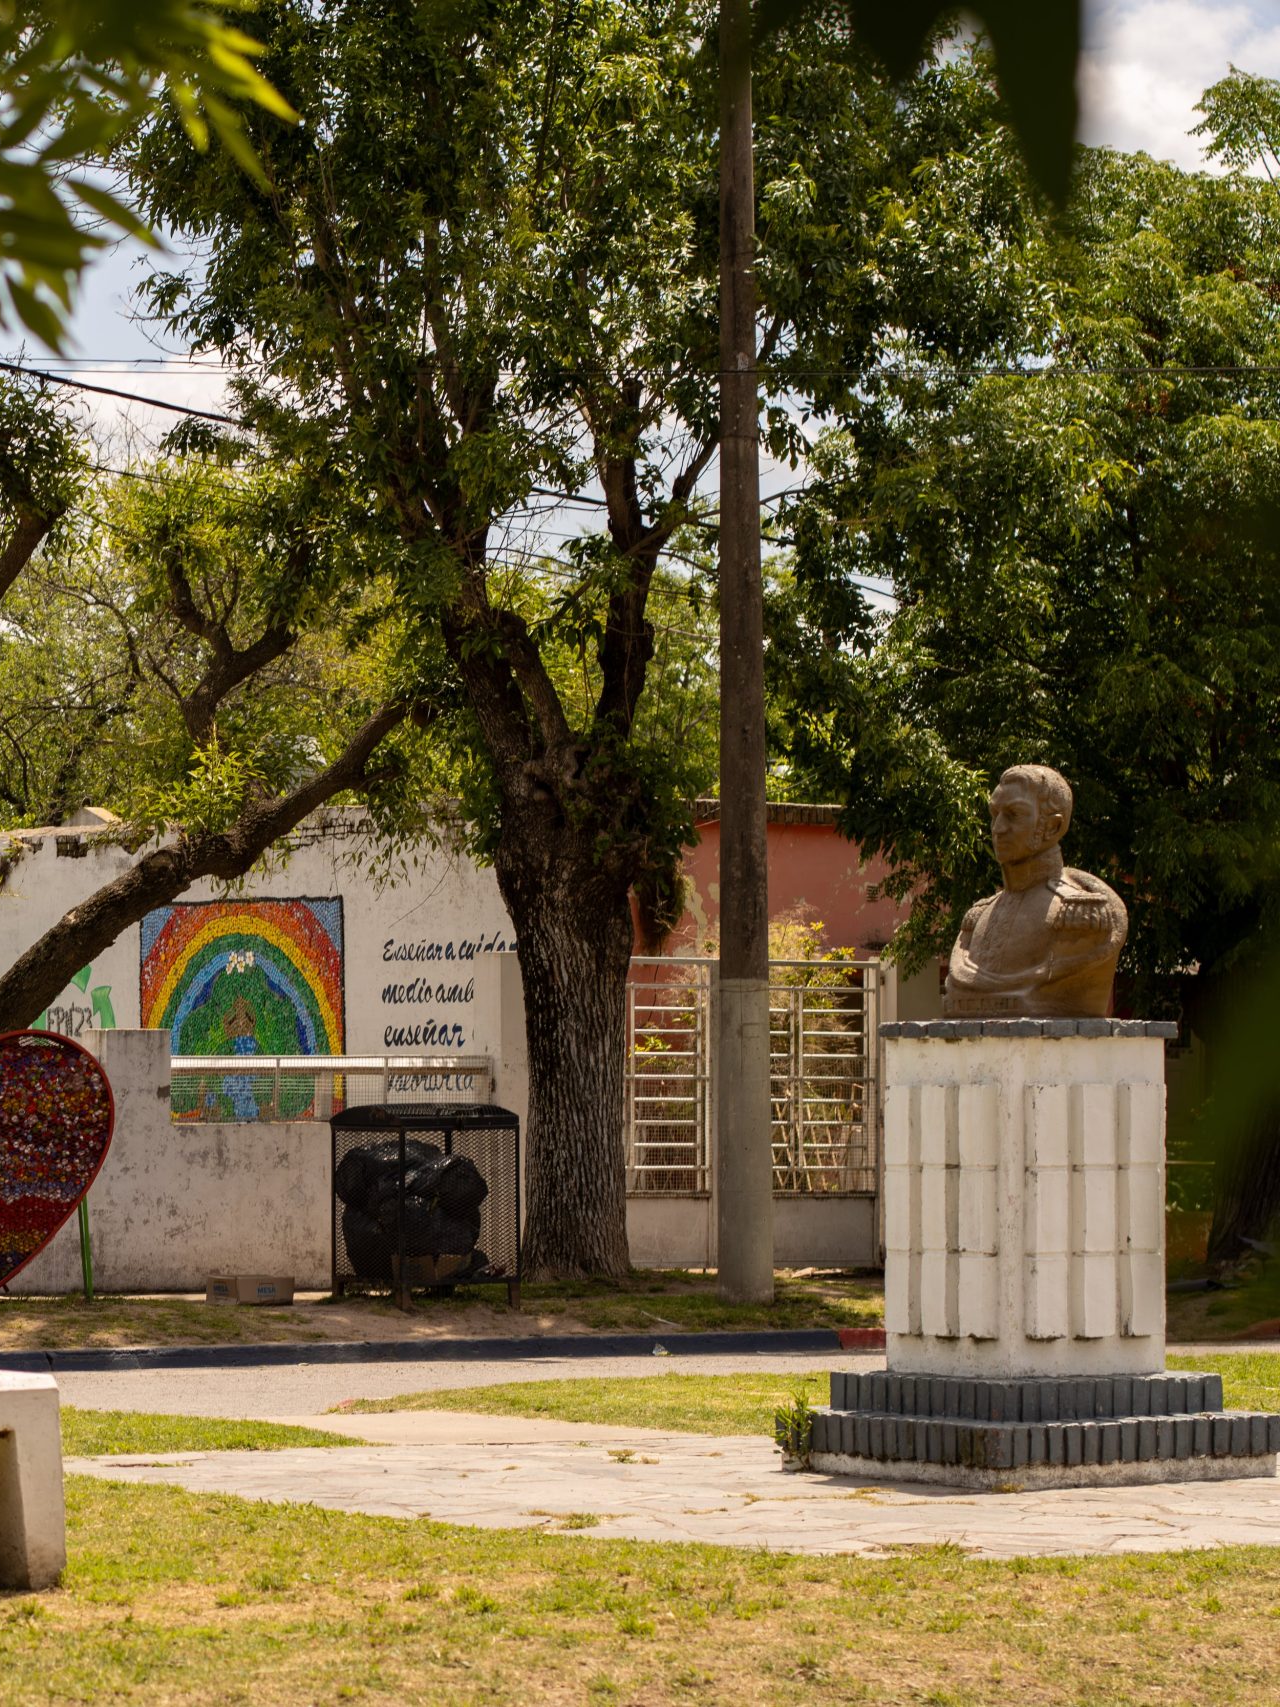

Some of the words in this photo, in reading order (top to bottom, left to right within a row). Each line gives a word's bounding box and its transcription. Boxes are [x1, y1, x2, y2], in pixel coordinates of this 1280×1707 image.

[381, 977, 434, 1005] medio
[435, 976, 474, 1004] amb
[383, 1018, 466, 1047] enseñar
